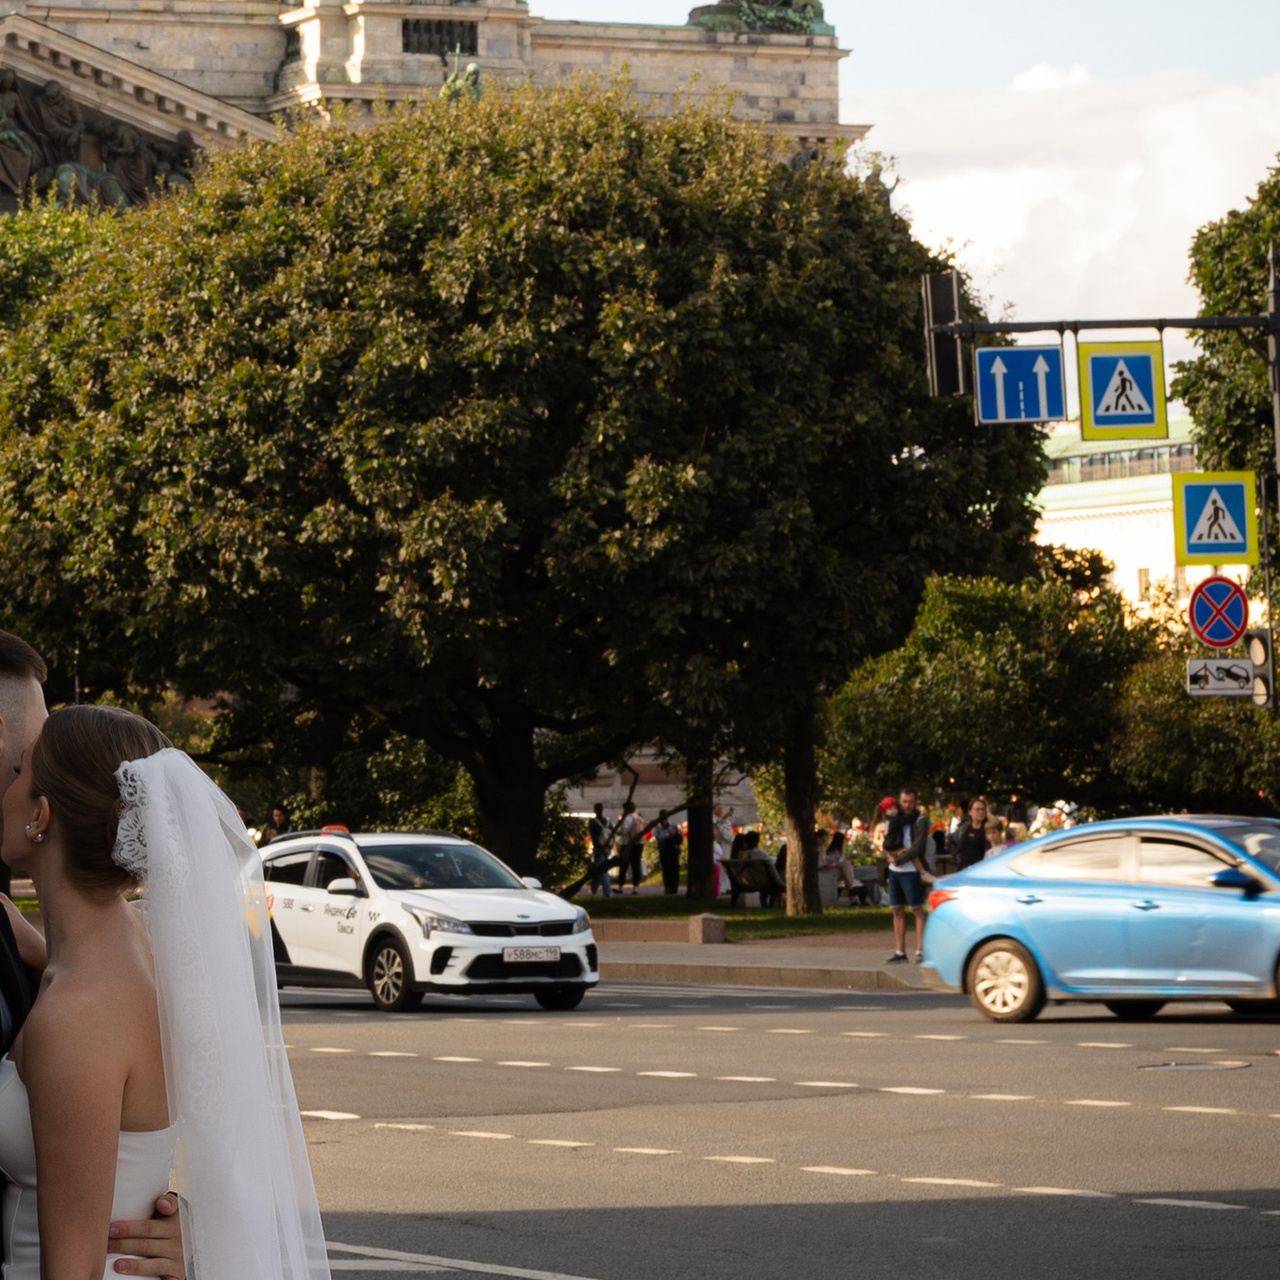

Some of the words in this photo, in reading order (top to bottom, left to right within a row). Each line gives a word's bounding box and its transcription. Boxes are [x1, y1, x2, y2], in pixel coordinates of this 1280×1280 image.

[282, 898, 294, 910] 588
[324, 904, 347, 917] Яндекс
[337, 921, 354, 935] Такси
